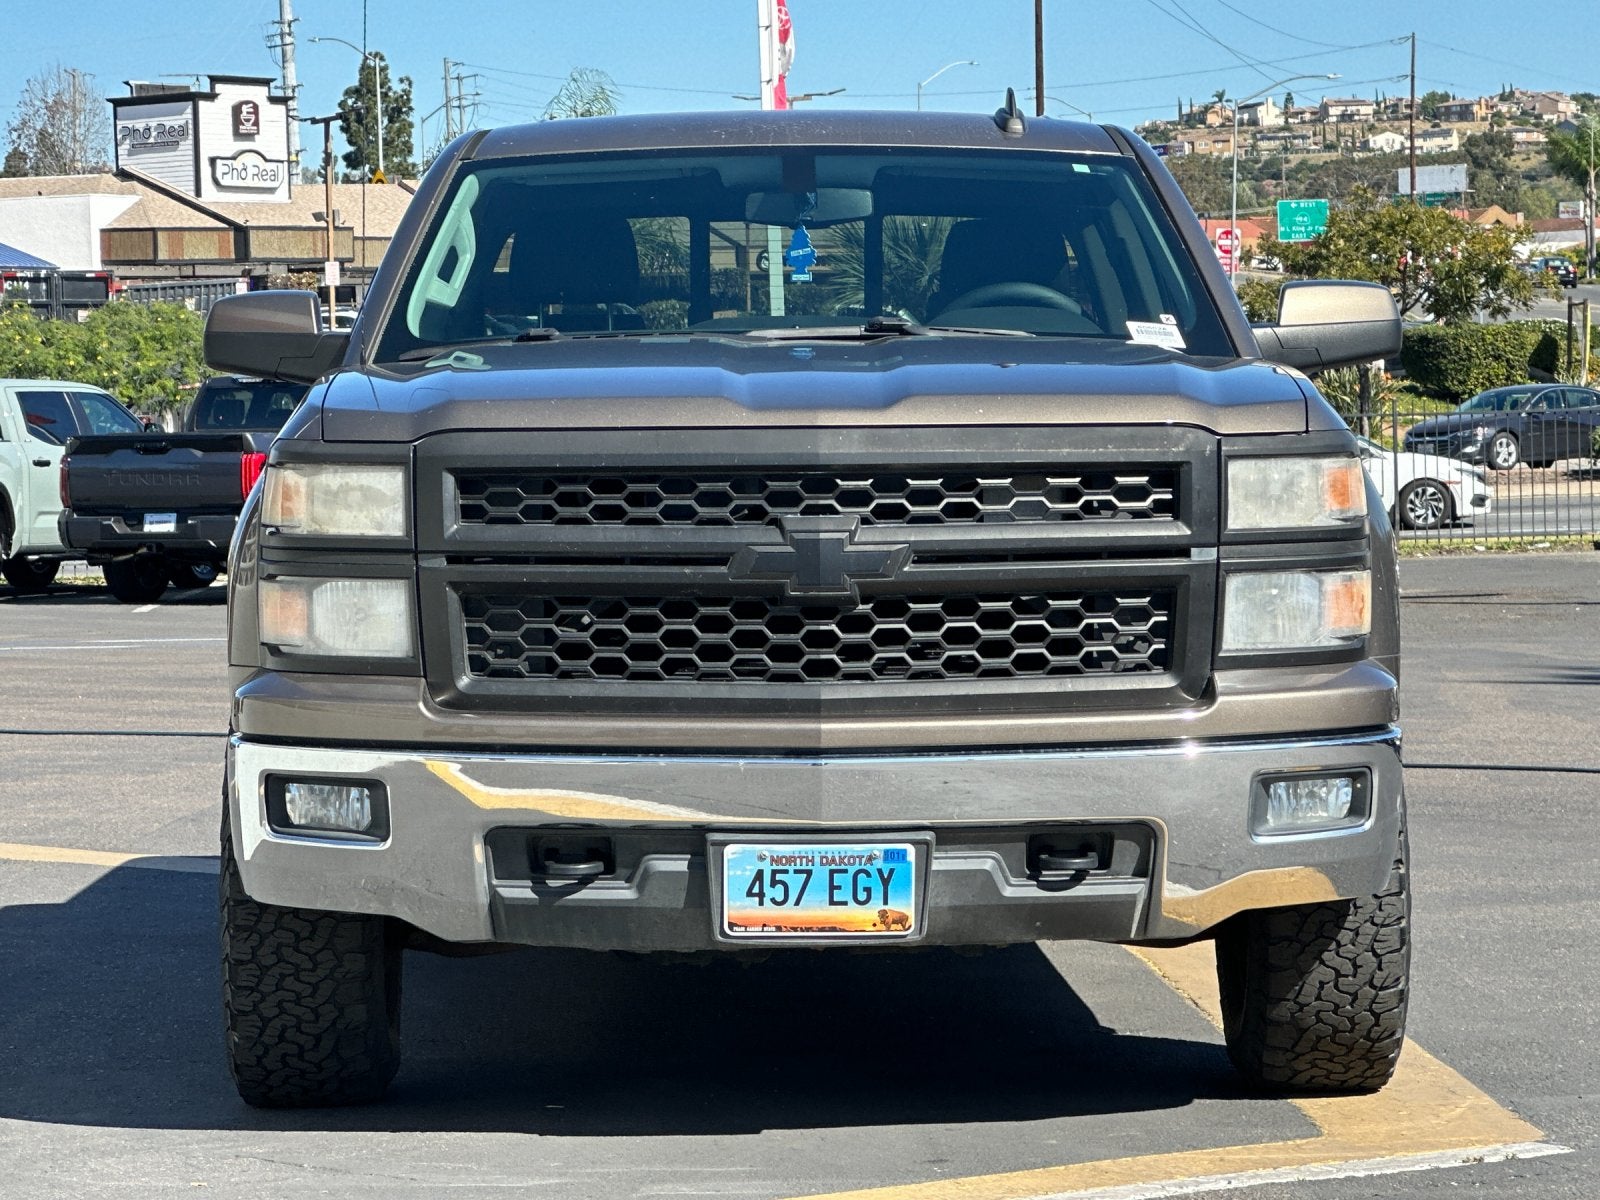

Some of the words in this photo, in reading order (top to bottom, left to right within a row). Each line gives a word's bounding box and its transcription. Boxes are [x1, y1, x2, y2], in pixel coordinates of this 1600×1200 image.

[156, 120, 189, 138] Real
[251, 164, 279, 182] Real
[104, 472, 200, 486] TUNDRA
[769, 855, 815, 867] NORTH
[819, 855, 873, 867] DAKOTA
[745, 868, 813, 907] 457
[828, 868, 896, 907] EGY
